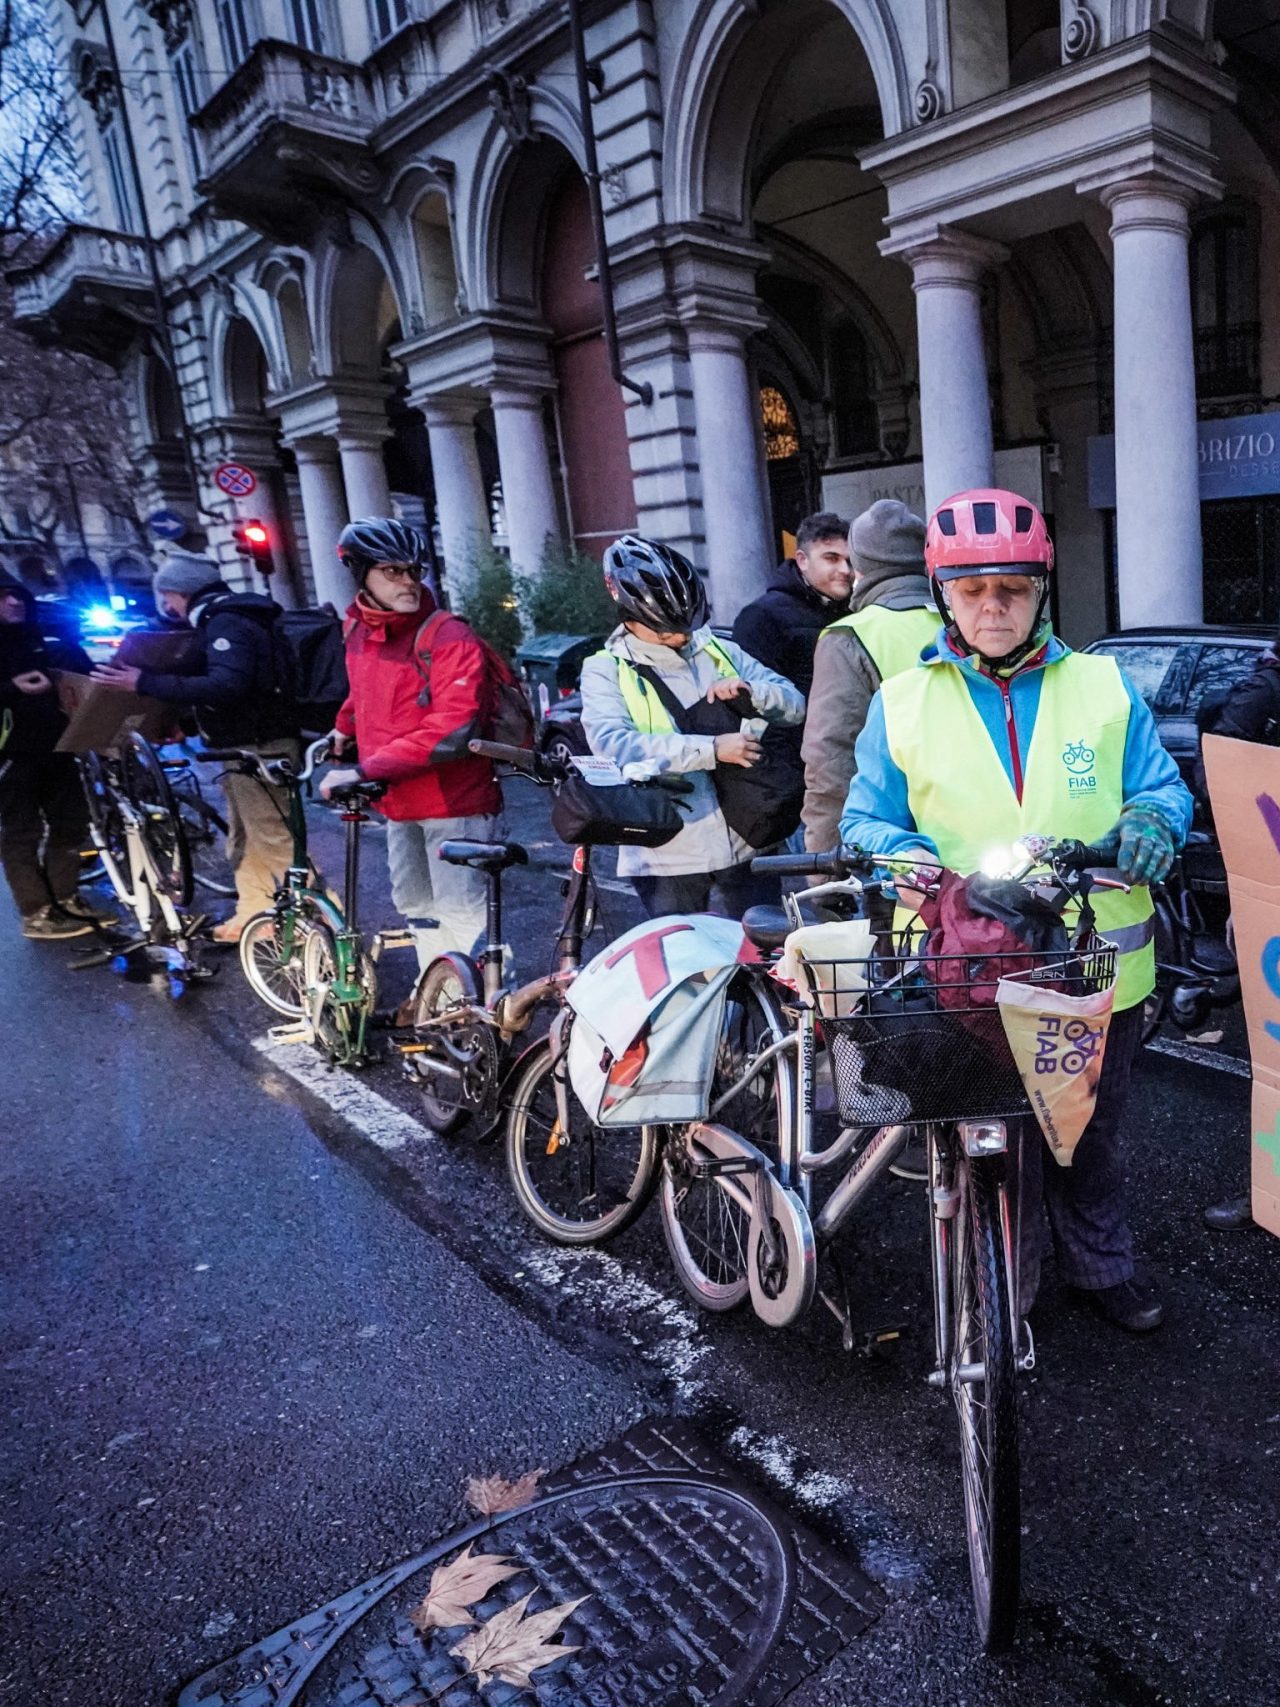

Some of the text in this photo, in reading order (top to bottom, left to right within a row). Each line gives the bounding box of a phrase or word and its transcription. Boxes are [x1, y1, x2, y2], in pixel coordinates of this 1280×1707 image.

[1068, 775, 1097, 789] FIAB
[1031, 969, 1066, 980] BRN
[1034, 1017, 1061, 1075] FIAB
